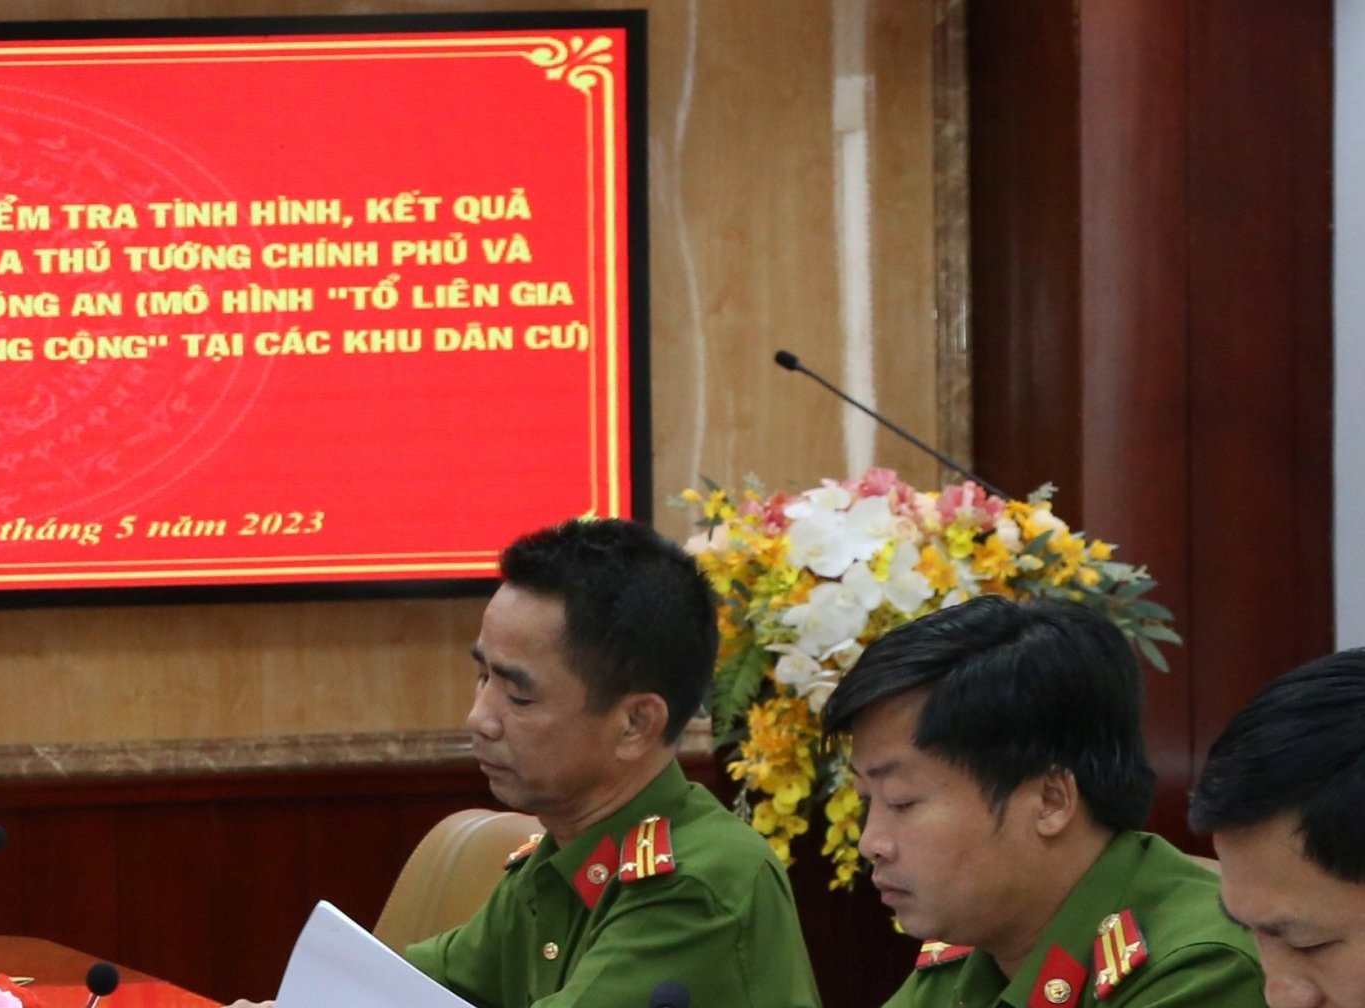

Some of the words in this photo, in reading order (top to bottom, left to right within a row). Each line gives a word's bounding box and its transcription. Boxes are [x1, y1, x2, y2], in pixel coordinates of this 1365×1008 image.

[61, 203, 139, 230] TRA
[147, 197, 238, 228] TÌNH
[250, 195, 354, 229] HÌNH,
[365, 190, 443, 224] KẾT
[453, 187, 532, 224] QUẢ
[33, 240, 111, 274] THỦ
[123, 240, 252, 273] TƯỚNG
[261, 237, 379, 269] CHÍNH
[391, 232, 468, 266] PHỦ
[481, 233, 532, 264] VÀ
[70, 292, 123, 317] AN
[135, 283, 210, 318] (MÔ
[222, 282, 314, 314] HÌNH
[327, 273, 401, 311] "TỔ
[412, 277, 500, 309] LIÊN
[509, 281, 574, 307] GIA
[43, 330, 168, 365] CỘNG"
[180, 332, 244, 362] TẠI
[253, 326, 331, 356] CÁC
[343, 328, 422, 354] KHU
[434, 322, 514, 352] DÂN
[524, 320, 589, 351] CƯ)
[115, 515, 137, 539] 5
[147, 516, 227, 538] năm
[239, 511, 325, 536] 2023
